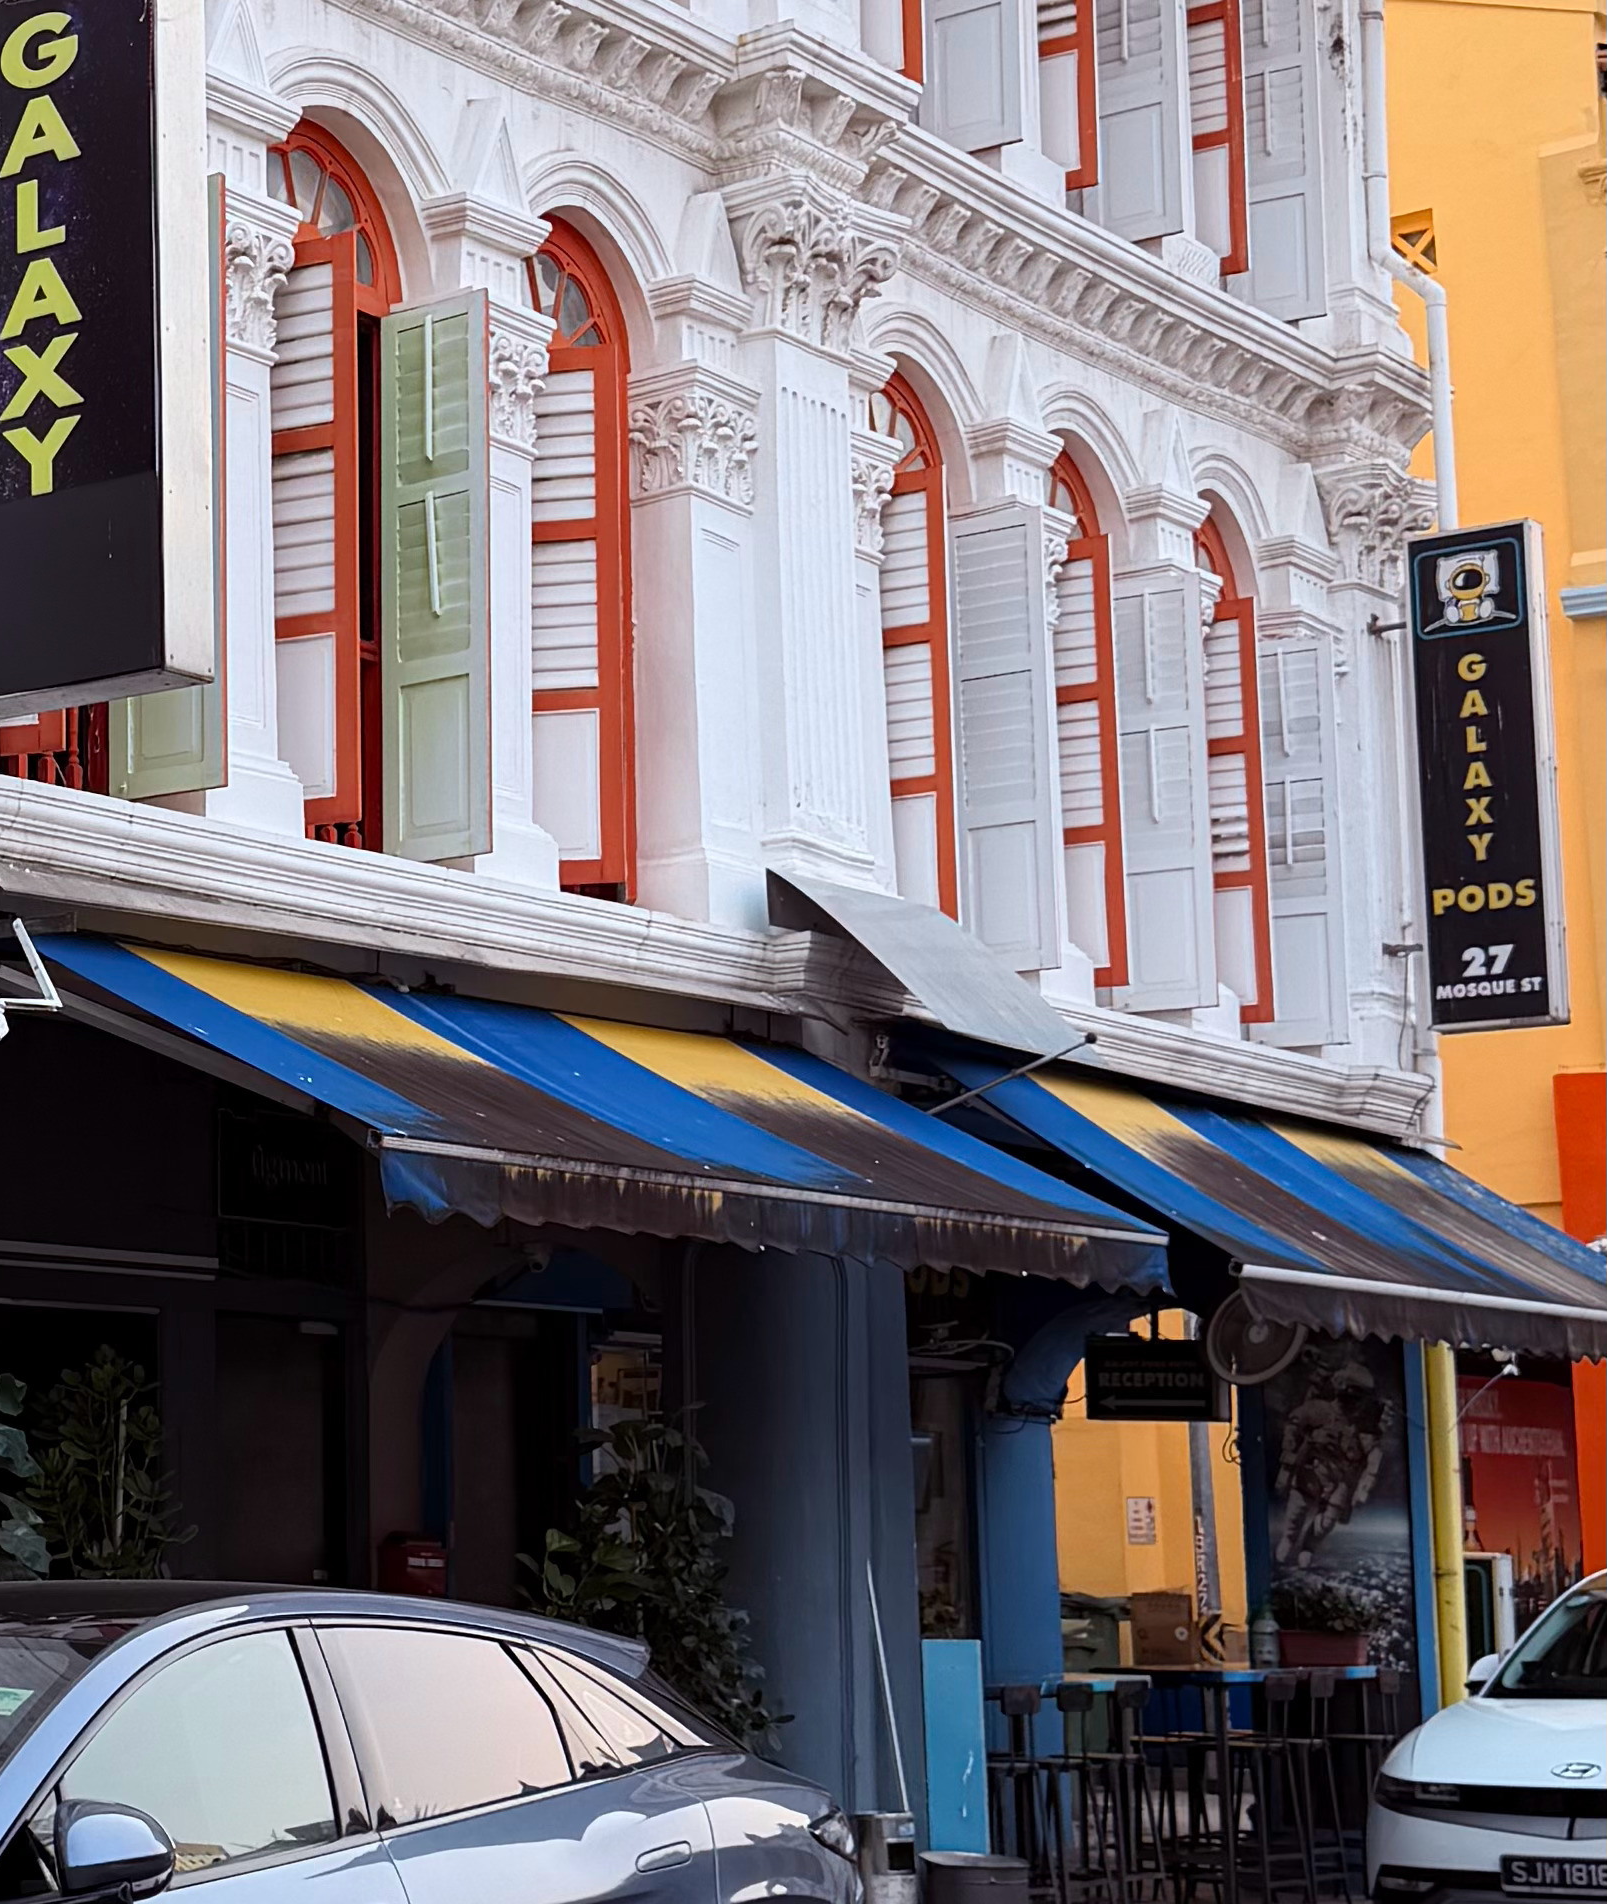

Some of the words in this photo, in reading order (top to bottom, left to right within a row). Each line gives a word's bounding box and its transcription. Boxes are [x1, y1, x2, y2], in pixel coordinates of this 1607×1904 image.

[1457, 652, 1493, 862] GALAXY
[1432, 878, 1537, 916] PODS
[1460, 944, 1515, 978] 27
[1435, 978, 1517, 1001] MOSQUE
[1520, 976, 1543, 993] ST
[1097, 1371, 1205, 1388] RECEPTION
